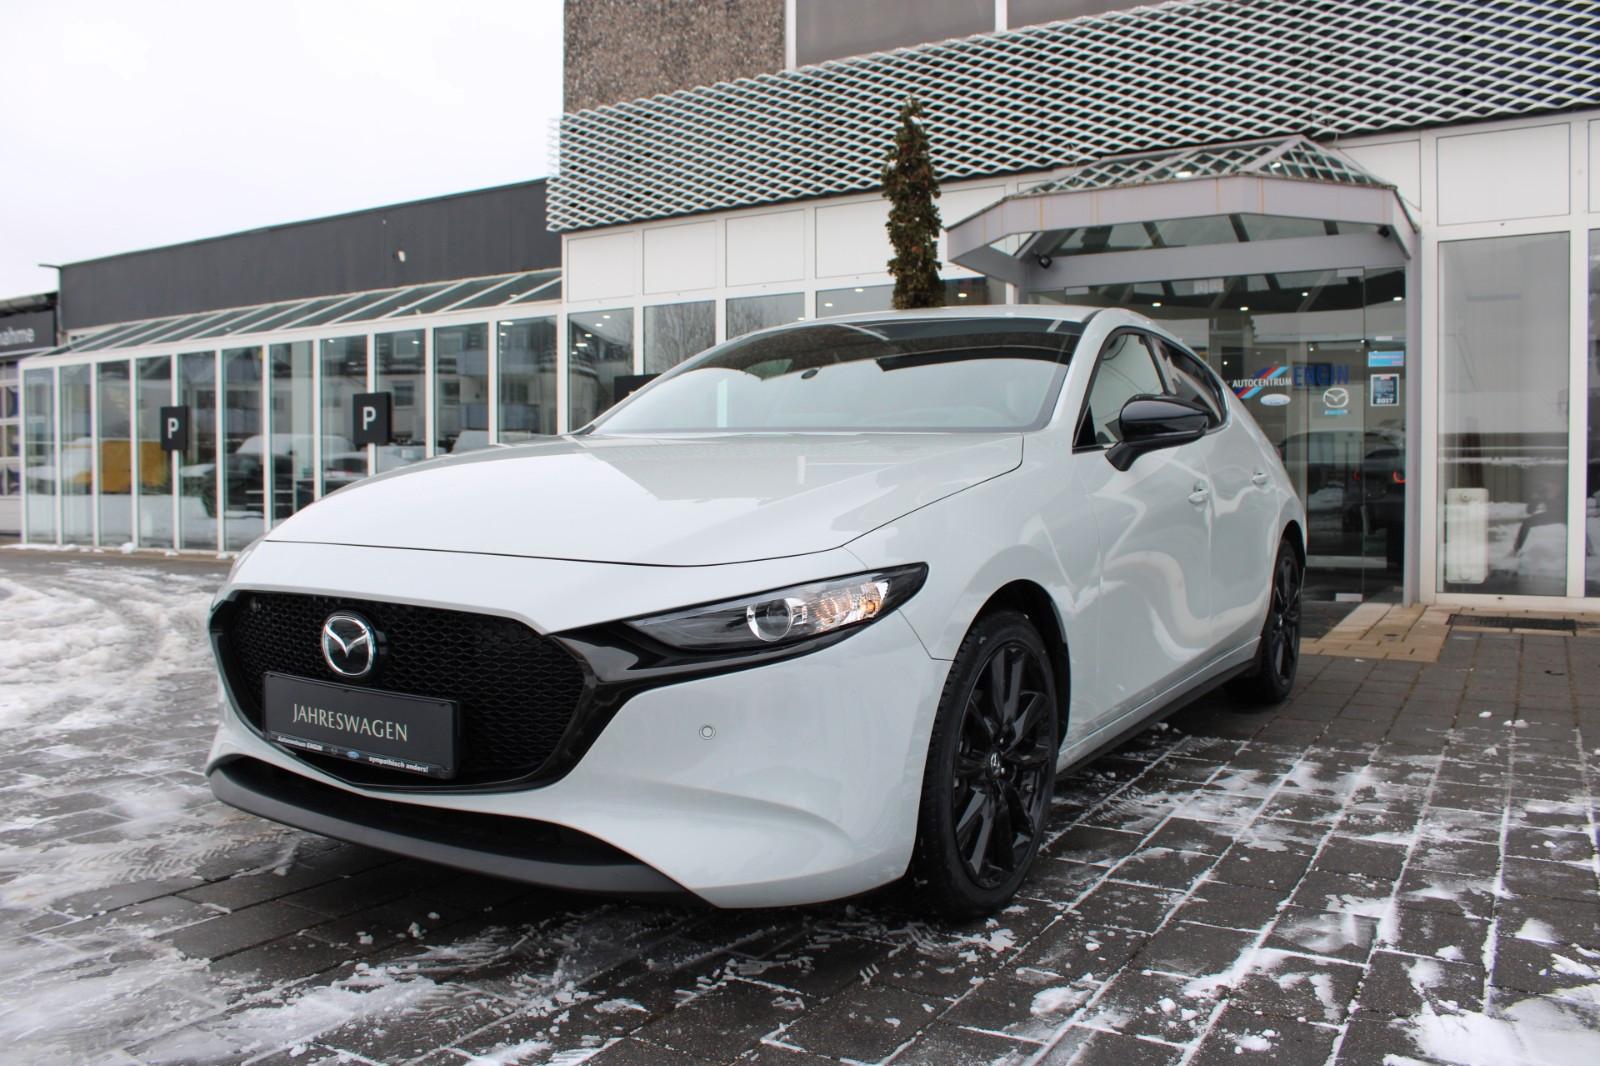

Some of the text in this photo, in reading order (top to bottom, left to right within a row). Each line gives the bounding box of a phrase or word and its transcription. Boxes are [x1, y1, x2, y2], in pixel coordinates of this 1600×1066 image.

[0, 326, 35, 346] ahme
[1233, 377, 1292, 388] AUTOCENTRUM
[167, 417, 179, 439] P
[363, 406, 377, 431] P
[293, 703, 407, 742] JAHRESWAGEN
